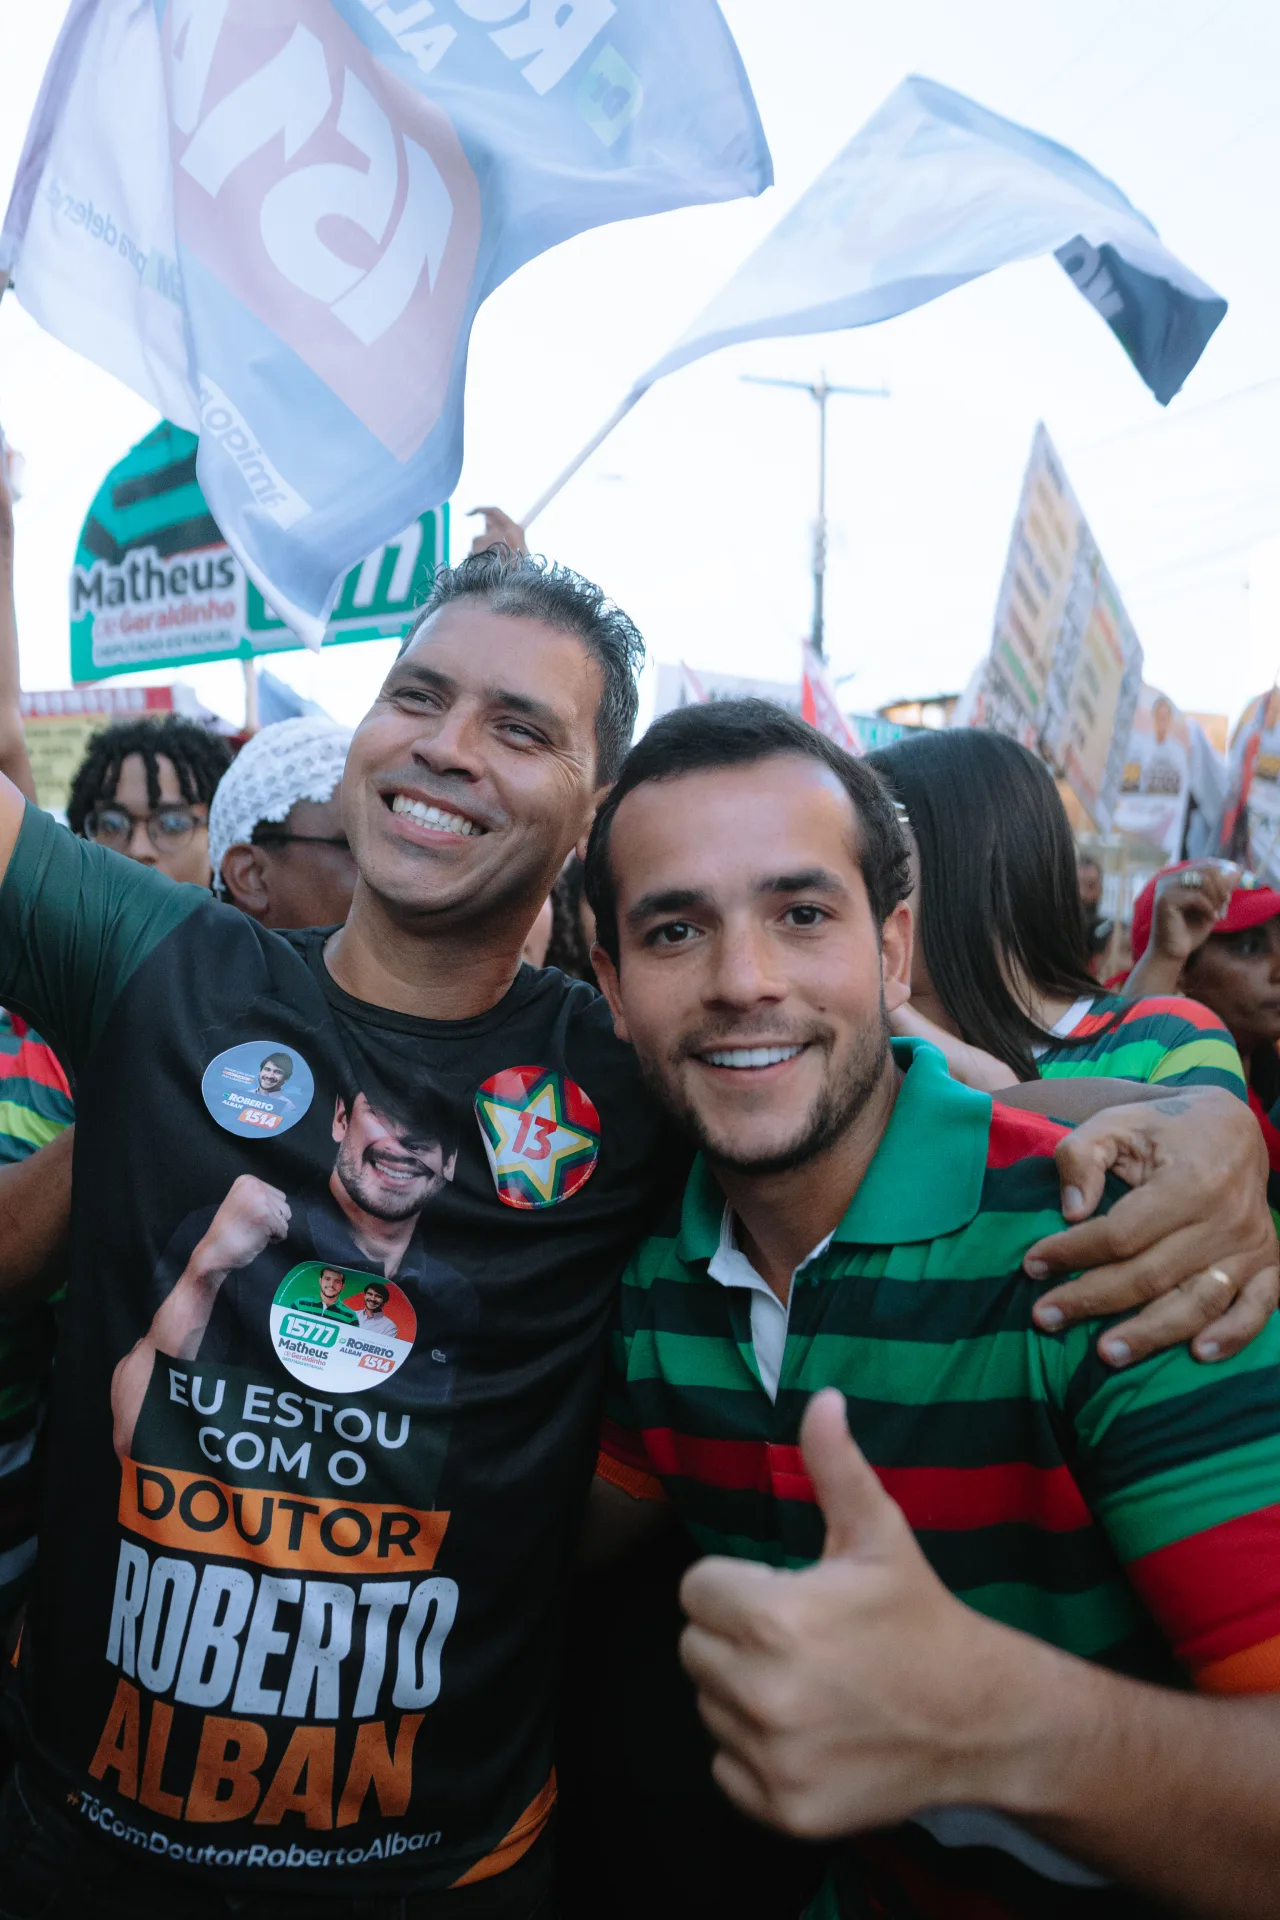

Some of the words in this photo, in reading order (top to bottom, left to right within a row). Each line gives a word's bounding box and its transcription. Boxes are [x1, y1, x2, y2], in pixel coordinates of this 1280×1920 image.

[73, 552, 235, 612] Matheus
[222, 1099, 244, 1110] ALBAN
[228, 1092, 274, 1112] ROBERTO
[245, 1109, 278, 1128] 1514
[511, 1111, 559, 1161] 13
[286, 1316, 336, 1344] 15777
[278, 1337, 329, 1360] Matheus
[290, 1351, 327, 1367] Geraldinho
[339, 1346, 362, 1357] ALBAN
[345, 1337, 394, 1359] ROBERTO
[363, 1355, 391, 1372] 1514
[168, 1367, 228, 1415] EU
[242, 1383, 411, 1450] ESTOU
[198, 1426, 313, 1480] COM
[327, 1449, 367, 1487] O
[136, 1466, 421, 1559] DOUTOR
[106, 1537, 460, 1720] ROBERTO
[87, 1678, 426, 1831] ALBAN
